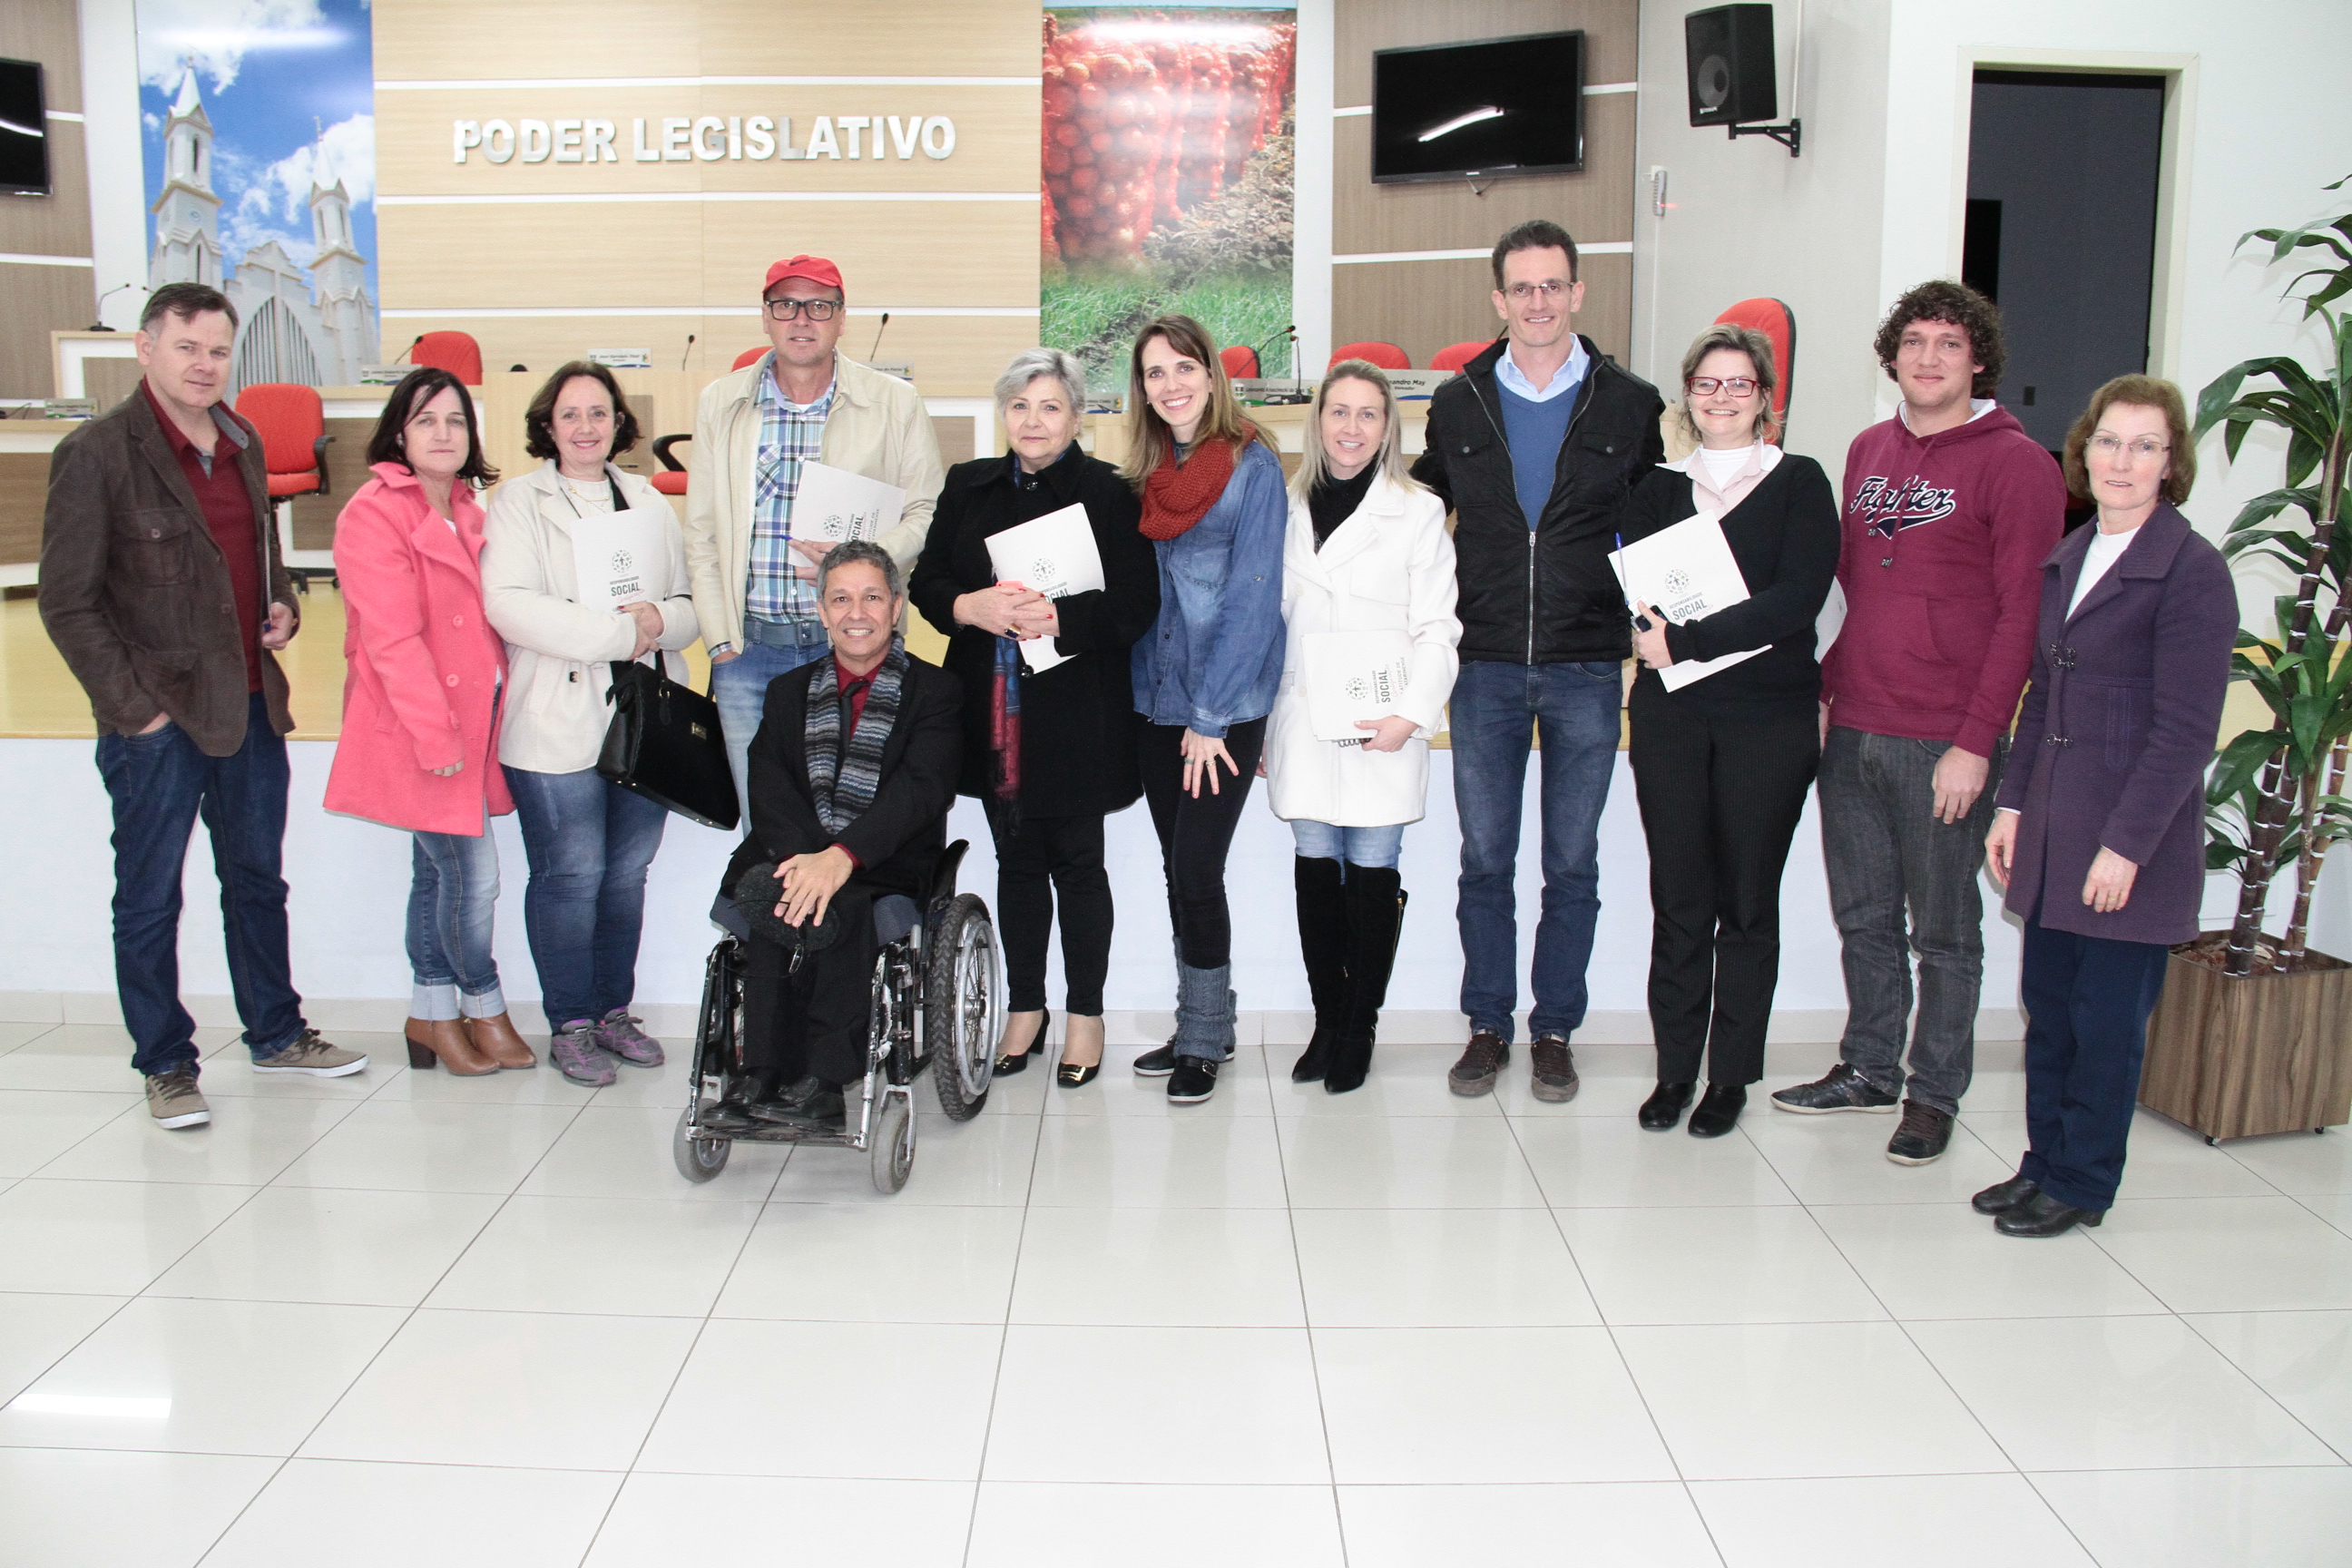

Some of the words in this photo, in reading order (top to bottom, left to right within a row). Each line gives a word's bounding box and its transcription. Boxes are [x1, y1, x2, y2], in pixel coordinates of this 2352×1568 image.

[454, 119, 618, 163] PODER
[633, 115, 956, 162] LEGISLATIVO
[1849, 475, 1955, 524] Fighter
[850, 516, 864, 543] OCIAL
[611, 582, 641, 596] SOCIAL
[1044, 588, 1069, 604] OCIAL
[1672, 599, 1708, 621] SOCIAL
[1378, 670, 1391, 703] SOCIAL
